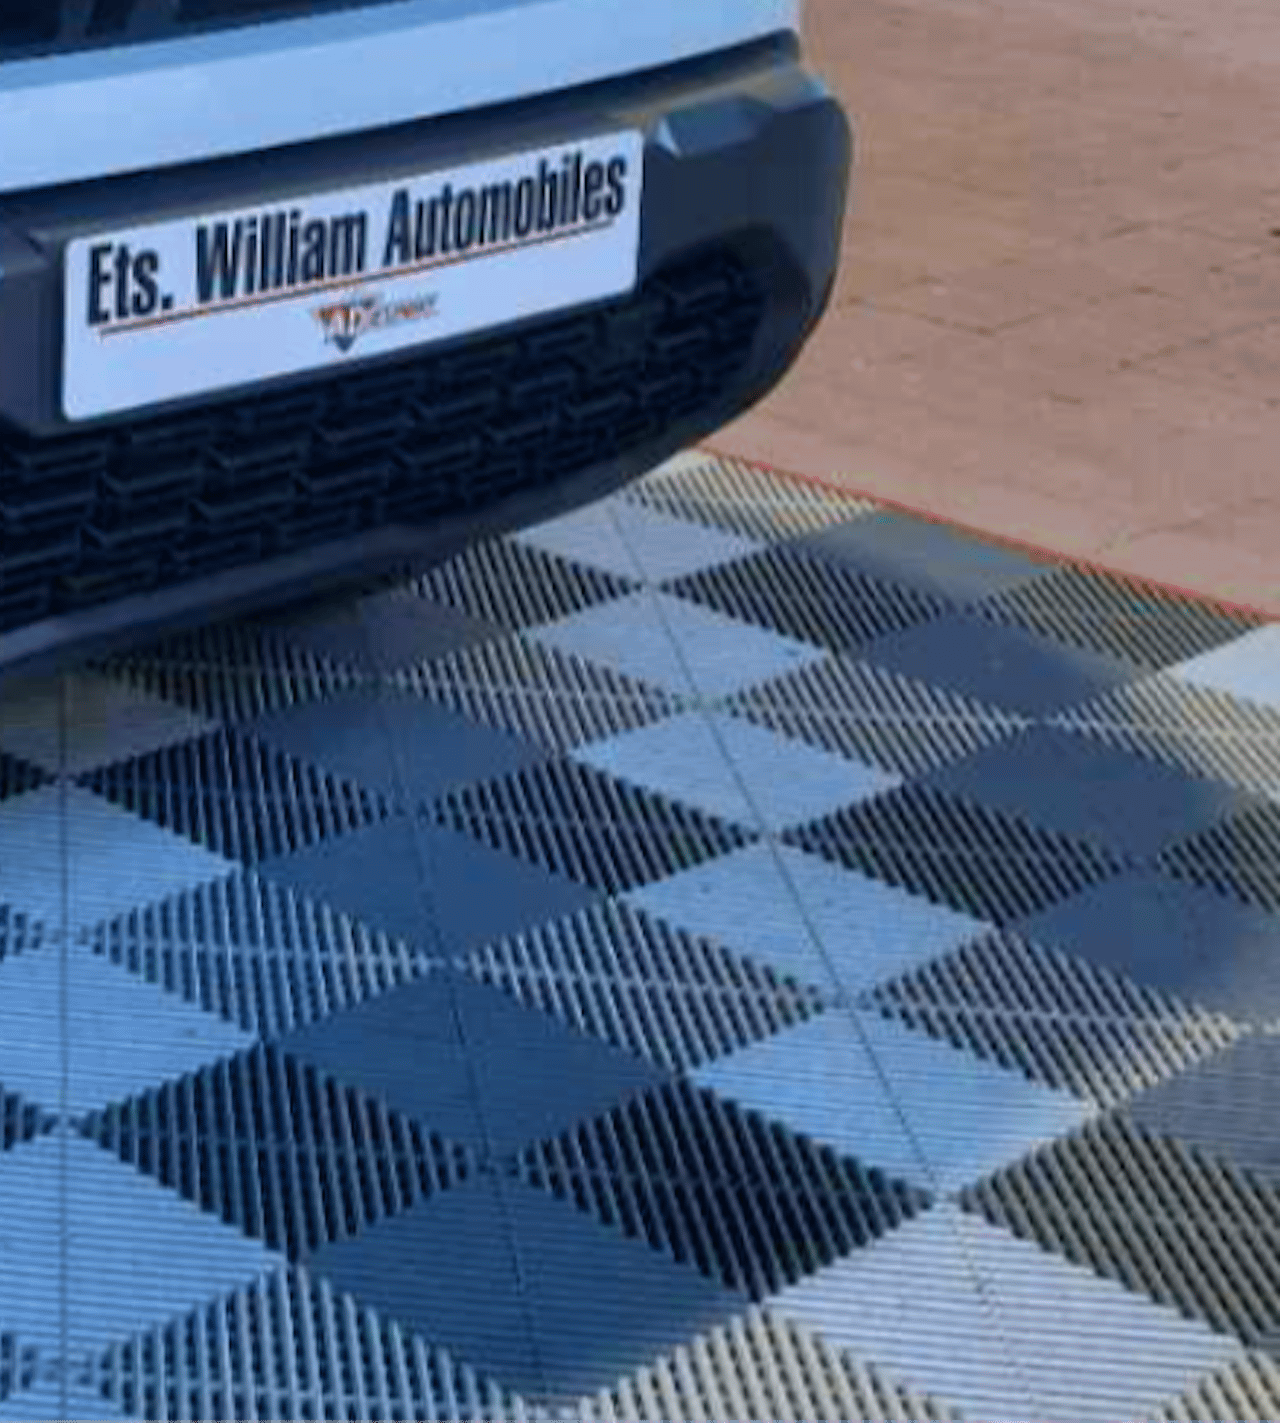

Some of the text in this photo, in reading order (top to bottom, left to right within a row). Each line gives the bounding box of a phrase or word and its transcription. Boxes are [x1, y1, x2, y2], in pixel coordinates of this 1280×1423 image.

[87, 152, 627, 324] Ets. William Automobiles
